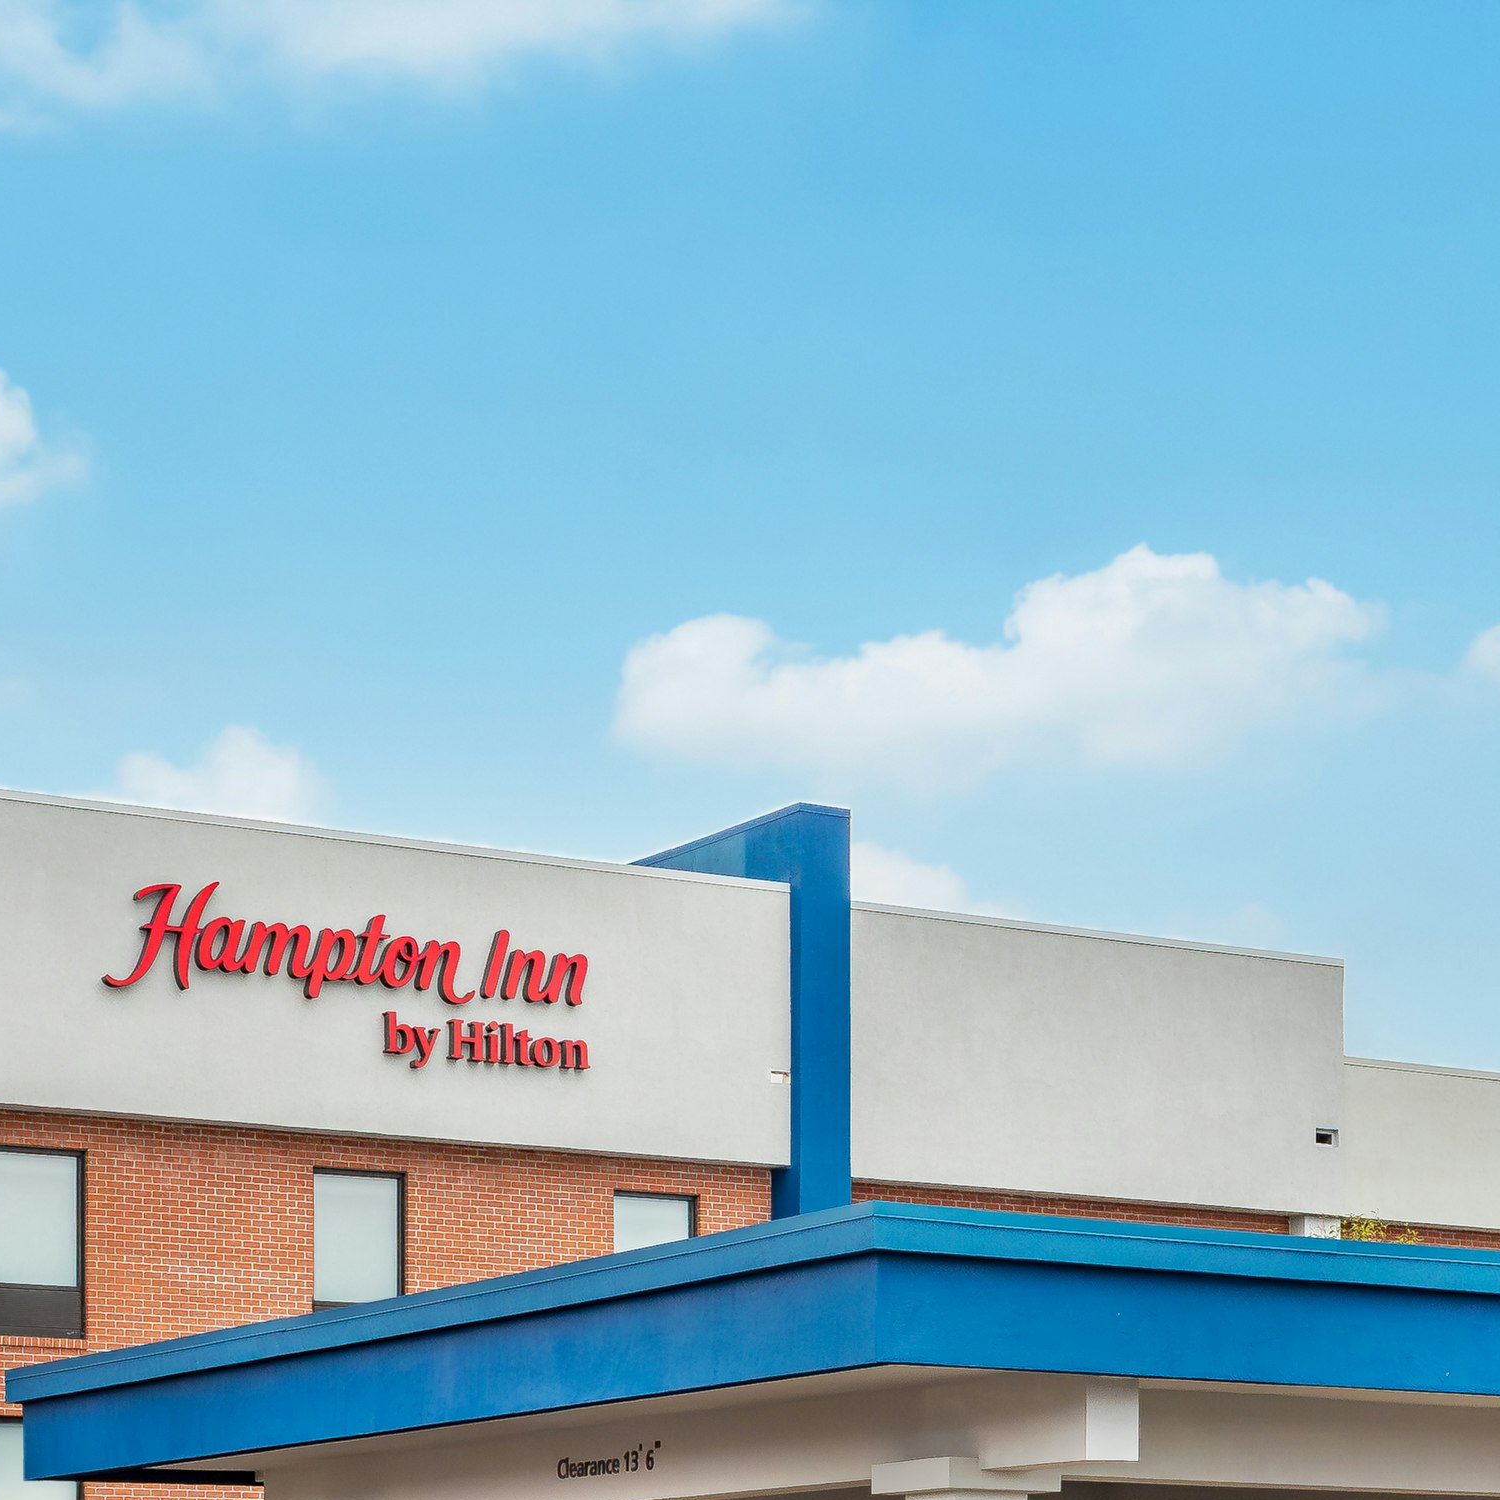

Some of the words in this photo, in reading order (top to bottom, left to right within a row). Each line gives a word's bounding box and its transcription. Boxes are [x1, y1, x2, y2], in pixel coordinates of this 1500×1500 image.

[101, 880, 475, 1005] Hampton
[479, 929, 589, 1007] Inn
[382, 1011, 442, 1069] by
[445, 1018, 591, 1071] Hilton
[557, 1456, 620, 1479] Clearance
[623, 1443, 643, 1472] 13'
